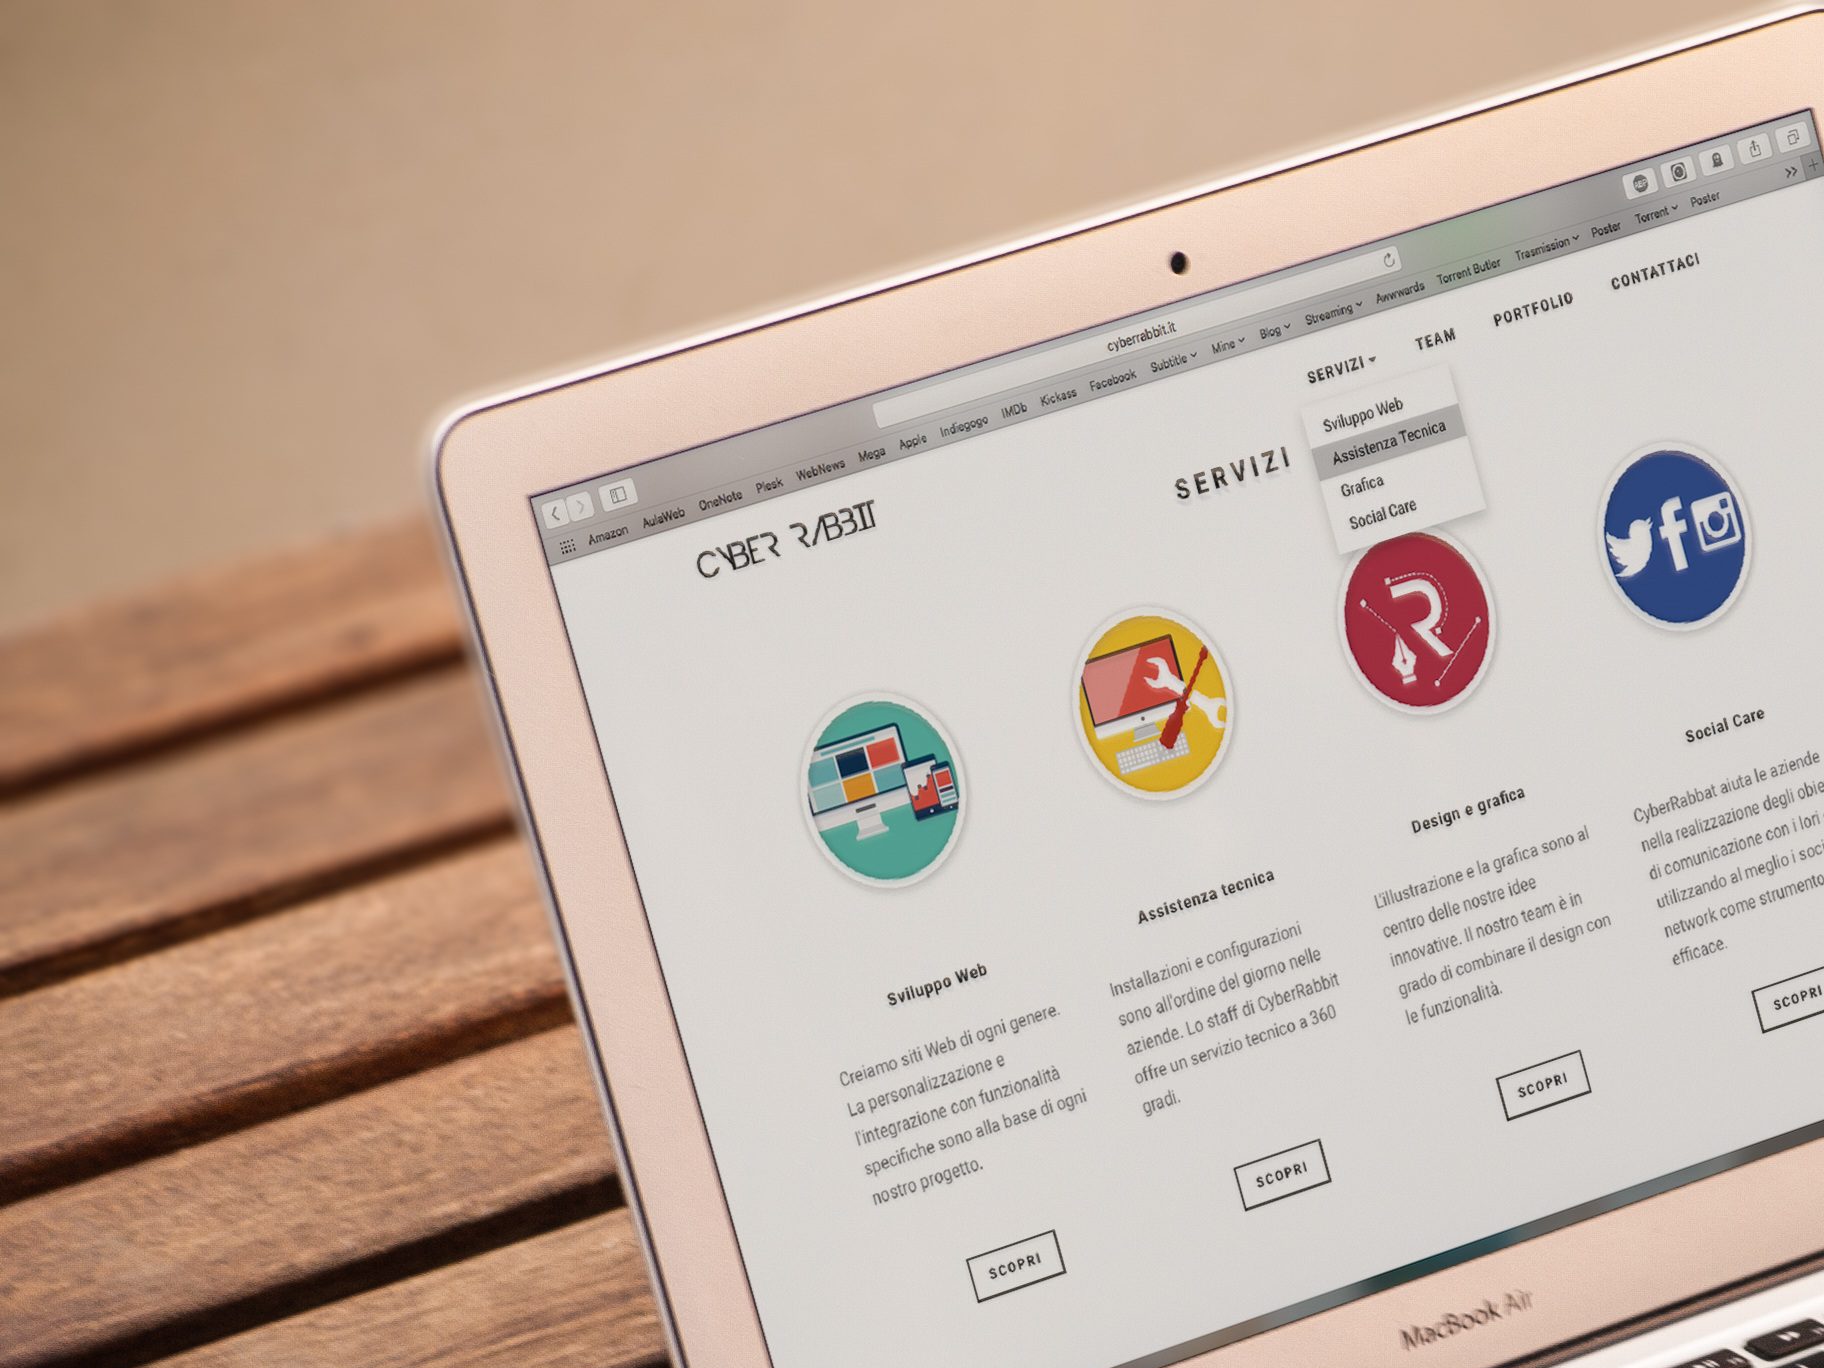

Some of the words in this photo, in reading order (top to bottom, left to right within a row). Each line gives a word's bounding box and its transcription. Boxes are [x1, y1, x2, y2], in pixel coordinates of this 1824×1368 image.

[1107, 321, 1177, 352] cyberrabbit.it
[1307, 355, 1365, 384] SERVIZI
[1414, 327, 1456, 351] TEAM
[1493, 291, 1574, 327] PORTFOLIO
[1610, 252, 1700, 290] CONTATTACI
[588, 526, 629, 546] Amazon
[642, 506, 685, 529] AulaWeb
[698, 490, 743, 511] OneNote
[755, 477, 784, 494] Plesk
[795, 459, 846, 481] WebNews
[857, 447, 886, 462] Mega
[899, 433, 927, 450] Apple
[939, 416, 989, 438] Indiegogo
[1000, 402, 1027, 419] IMDb
[1039, 388, 1077, 407] Kickass
[1089, 368, 1137, 392] Facebook
[1150, 354, 1187, 373] Subtitle
[1211, 340, 1236, 354] Mine
[1259, 326, 1282, 340] Blog
[1304, 304, 1354, 326] Streaming
[1376, 281, 1425, 304] Awwwards
[1436, 266, 1472, 284] Torrent
[1472, 258, 1501, 274] Butler
[1590, 222, 1621, 238] Poster
[1634, 205, 1670, 224] Torrent
[1689, 191, 1720, 207] Poster
[1322, 408, 1375, 433] Sviluppo
[1375, 396, 1404, 416] Web
[1333, 436, 1398, 466] Assistenza
[1397, 421, 1447, 443] Tecnica
[1174, 446, 1290, 500] SERVIZI
[1340, 476, 1385, 497] Grafica
[1348, 506, 1387, 530] Social
[1387, 499, 1417, 518] Care
[1684, 717, 1729, 743] Social
[1732, 709, 1765, 727] Care
[1411, 809, 1461, 834] Design
[1464, 804, 1474, 816] e
[1477, 787, 1525, 816] grafica
[1633, 783, 1718, 824] CyberRabbat
[1719, 774, 1753, 794] aiuta
[1753, 767, 1768, 783] le
[1769, 750, 1820, 778] aziende
[1640, 830, 1674, 852] nella
[1675, 802, 1760, 841] realizzazione
[1762, 788, 1795, 811] degli
[1465, 866, 1475, 879] e
[1475, 860, 1491, 875] la
[1492, 845, 1539, 874] grafica
[1541, 834, 1575, 854] sono
[1576, 824, 1590, 842] al
[1648, 863, 1662, 880] di
[1664, 832, 1763, 875] comunicazione
[1765, 823, 1790, 841] con
[1791, 818, 1797, 832] i
[1138, 889, 1218, 924] Assistenza
[1220, 870, 1275, 896] tecnica
[1382, 914, 1425, 938] centro
[1427, 900, 1461, 923] delle
[1462, 887, 1505, 912] nostre
[1507, 877, 1537, 897] idee
[1656, 874, 1727, 909] utilizzando
[1729, 866, 1743, 884] al
[1744, 854, 1790, 879] meglio
[1790, 849, 1796, 863] i
[1664, 907, 1719, 938] network
[1719, 897, 1756, 919] come
[1758, 873, 1824, 906] strumento
[1389, 934, 1462, 967] innovative.
[1463, 926, 1474, 942] Il
[1475, 914, 1519, 938] nostro
[1520, 902, 1556, 923] team
[1558, 895, 1568, 910] è
[1568, 892, 1583, 907] in
[1398, 972, 1437, 1000] grado
[1439, 964, 1453, 982] di
[1455, 943, 1526, 976] combinare
[1527, 935, 1537, 952] il
[1538, 924, 1584, 948] design
[1586, 915, 1612, 932] con
[1671, 938, 1728, 966] efficace.
[886, 976, 952, 1006] Sviluppo
[954, 962, 987, 984] Web
[1109, 956, 1193, 997] Installazioni
[1194, 956, 1204, 969] e
[1206, 920, 1302, 965] configurazioni
[1118, 1005, 1152, 1027] sono
[1155, 984, 1217, 1014] all'ordine
[1218, 972, 1240, 993] del
[1242, 961, 1286, 988] giorno
[1288, 947, 1321, 970] nelle
[1126, 1027, 1184, 1056] aziende.
[1185, 1019, 1204, 1036] Lo
[1206, 1003, 1238, 1028] staff
[1241, 999, 1256, 1017] di
[1257, 972, 1340, 1012] CyberRabbit
[1404, 1009, 1419, 1025] le
[1420, 980, 1503, 1020] funzionalità.
[1773, 984, 1822, 1011] SCOPRI
[839, 1058, 898, 1087] Creiamo
[900, 1046, 923, 1067] siti
[923, 1036, 957, 1058] Web
[959, 1029, 973, 1047] di
[976, 1018, 1007, 1043] ogni
[1009, 1006, 1061, 1034] genere.
[1134, 1063, 1167, 1084] offre
[1169, 1057, 1188, 1073] un
[1190, 1038, 1243, 1066] servizio
[1244, 1021, 1296, 1047] tecnico
[1299, 1017, 1308, 1029] a
[1309, 1003, 1337, 1025] 360
[846, 1101, 866, 1117] La
[867, 1058, 993, 1114] personalizzazione
[995, 1054, 1005, 1068] e
[854, 1105, 948, 1146] l'integrazione
[950, 1096, 977, 1114] con
[978, 1064, 1061, 1105] funzionalità
[1142, 1089, 1181, 1117] gradi.
[1517, 1072, 1568, 1098] SCOPRI
[864, 1142, 936, 1177] specifiche
[937, 1129, 973, 1150] sono
[975, 1118, 1001, 1138] alla
[1001, 1108, 1038, 1129] base
[1040, 1098, 1054, 1116] di
[1056, 1087, 1087, 1112] ogni
[872, 1180, 917, 1206] nostro
[919, 1159, 984, 1193] progetto.
[1255, 1161, 1307, 1188] SCOPRI
[988, 1252, 1041, 1280] SCOPRI
[1399, 1297, 1503, 1351] MacBook
[1504, 1289, 1534, 1315] Air
